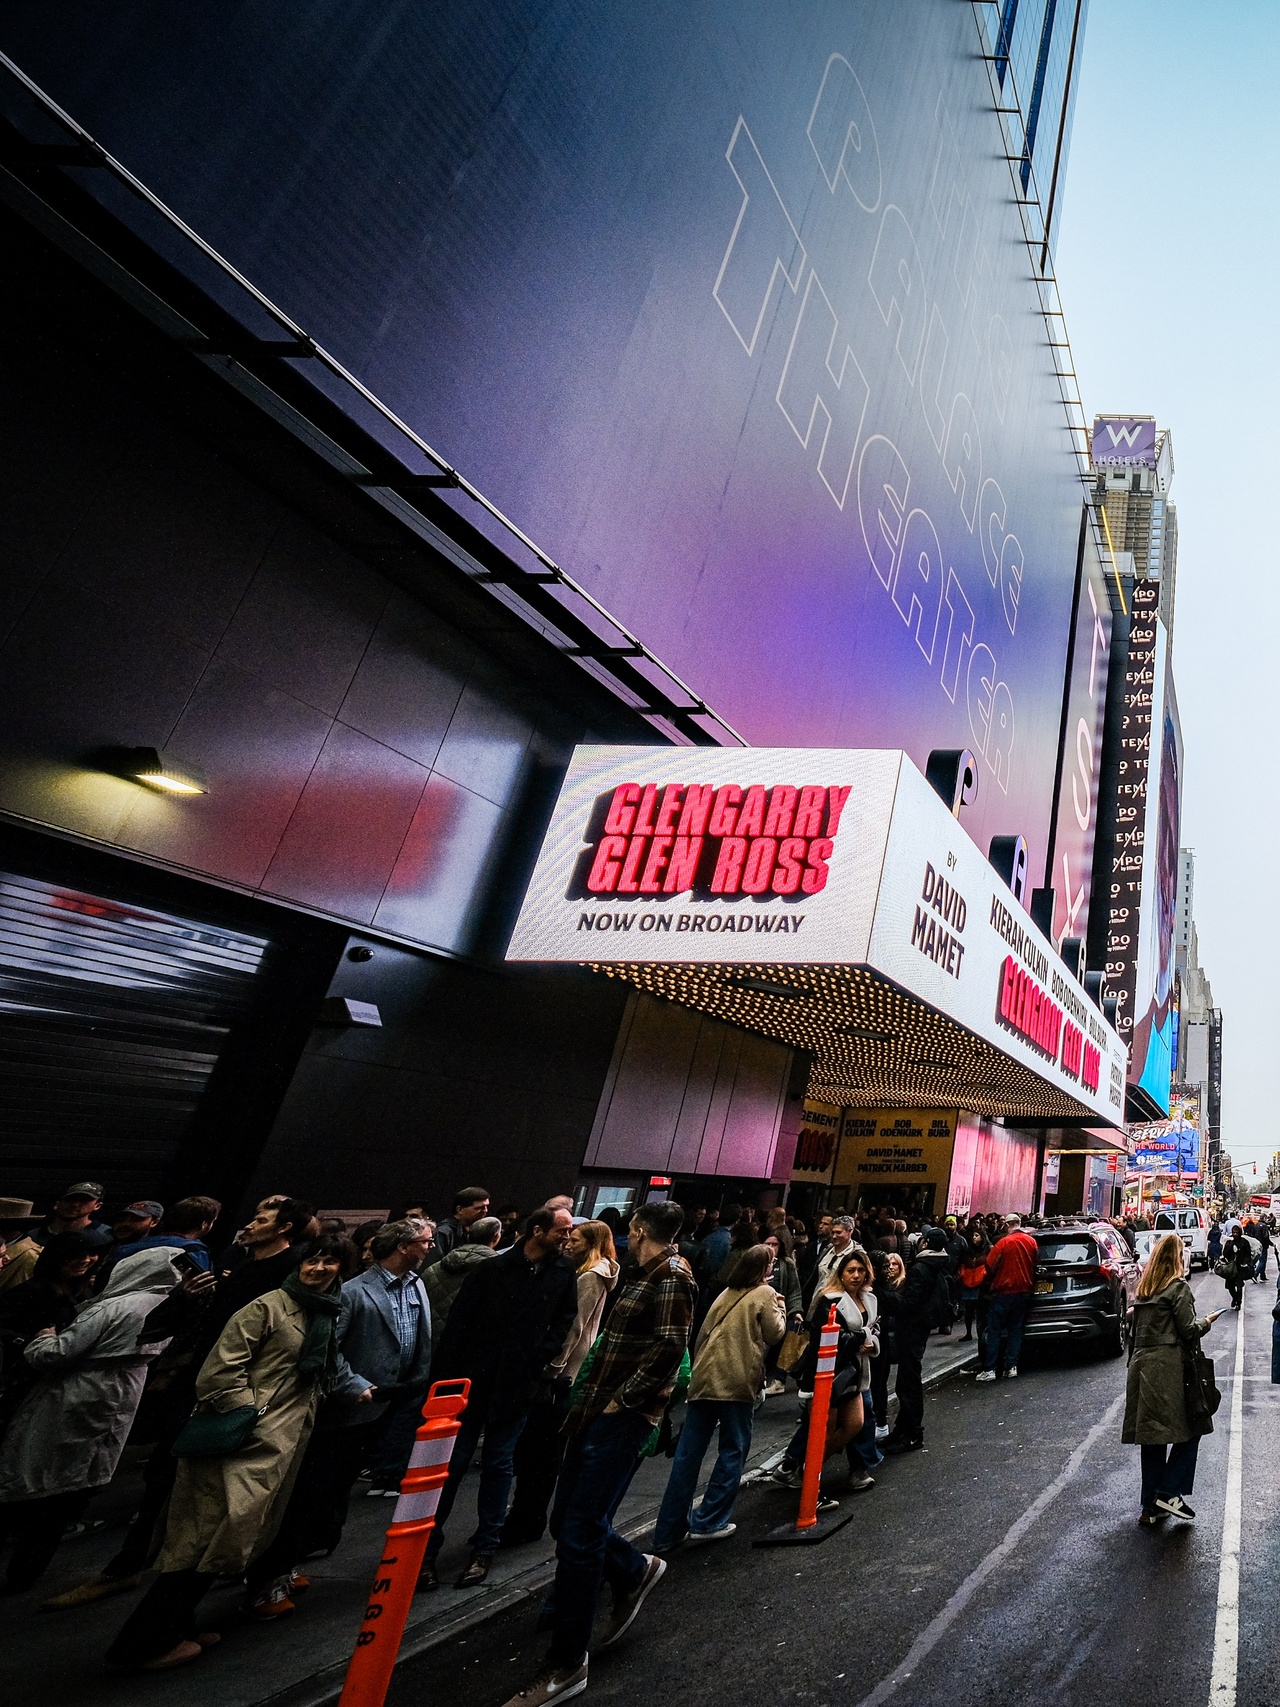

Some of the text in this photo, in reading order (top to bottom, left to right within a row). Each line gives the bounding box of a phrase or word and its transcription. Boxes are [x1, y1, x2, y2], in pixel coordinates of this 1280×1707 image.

[1106, 424, 1143, 448] W
[1099, 455, 1147, 464] HOTELS
[604, 782, 854, 838] GLENGARRY
[586, 835, 835, 896] GLEN ROSS
[948, 851, 957, 872] BY
[922, 860, 968, 935] DAVID
[576, 912, 806, 934] NOW ON BROADWAY
[910, 903, 965, 981] MAMET
[990, 893, 1024, 959] KIERAN
[1023, 934, 1049, 987] CULKIN
[1051, 968, 1064, 1004] BOB
[1063, 983, 1089, 1031] ODENKIRK
[1000, 954, 1101, 1092] GLENGARRY GLEN ROSS
[844, 1127, 951, 1138] CULKIN ODENKIRK BURR
[845, 1119, 949, 1129] KIERAN BOB BILL
[1133, 1127, 1172, 1142] SERVE
[866, 1148, 923, 1158] DAVID MAMET
[857, 1163, 928, 1173] PATRICK MARBER
